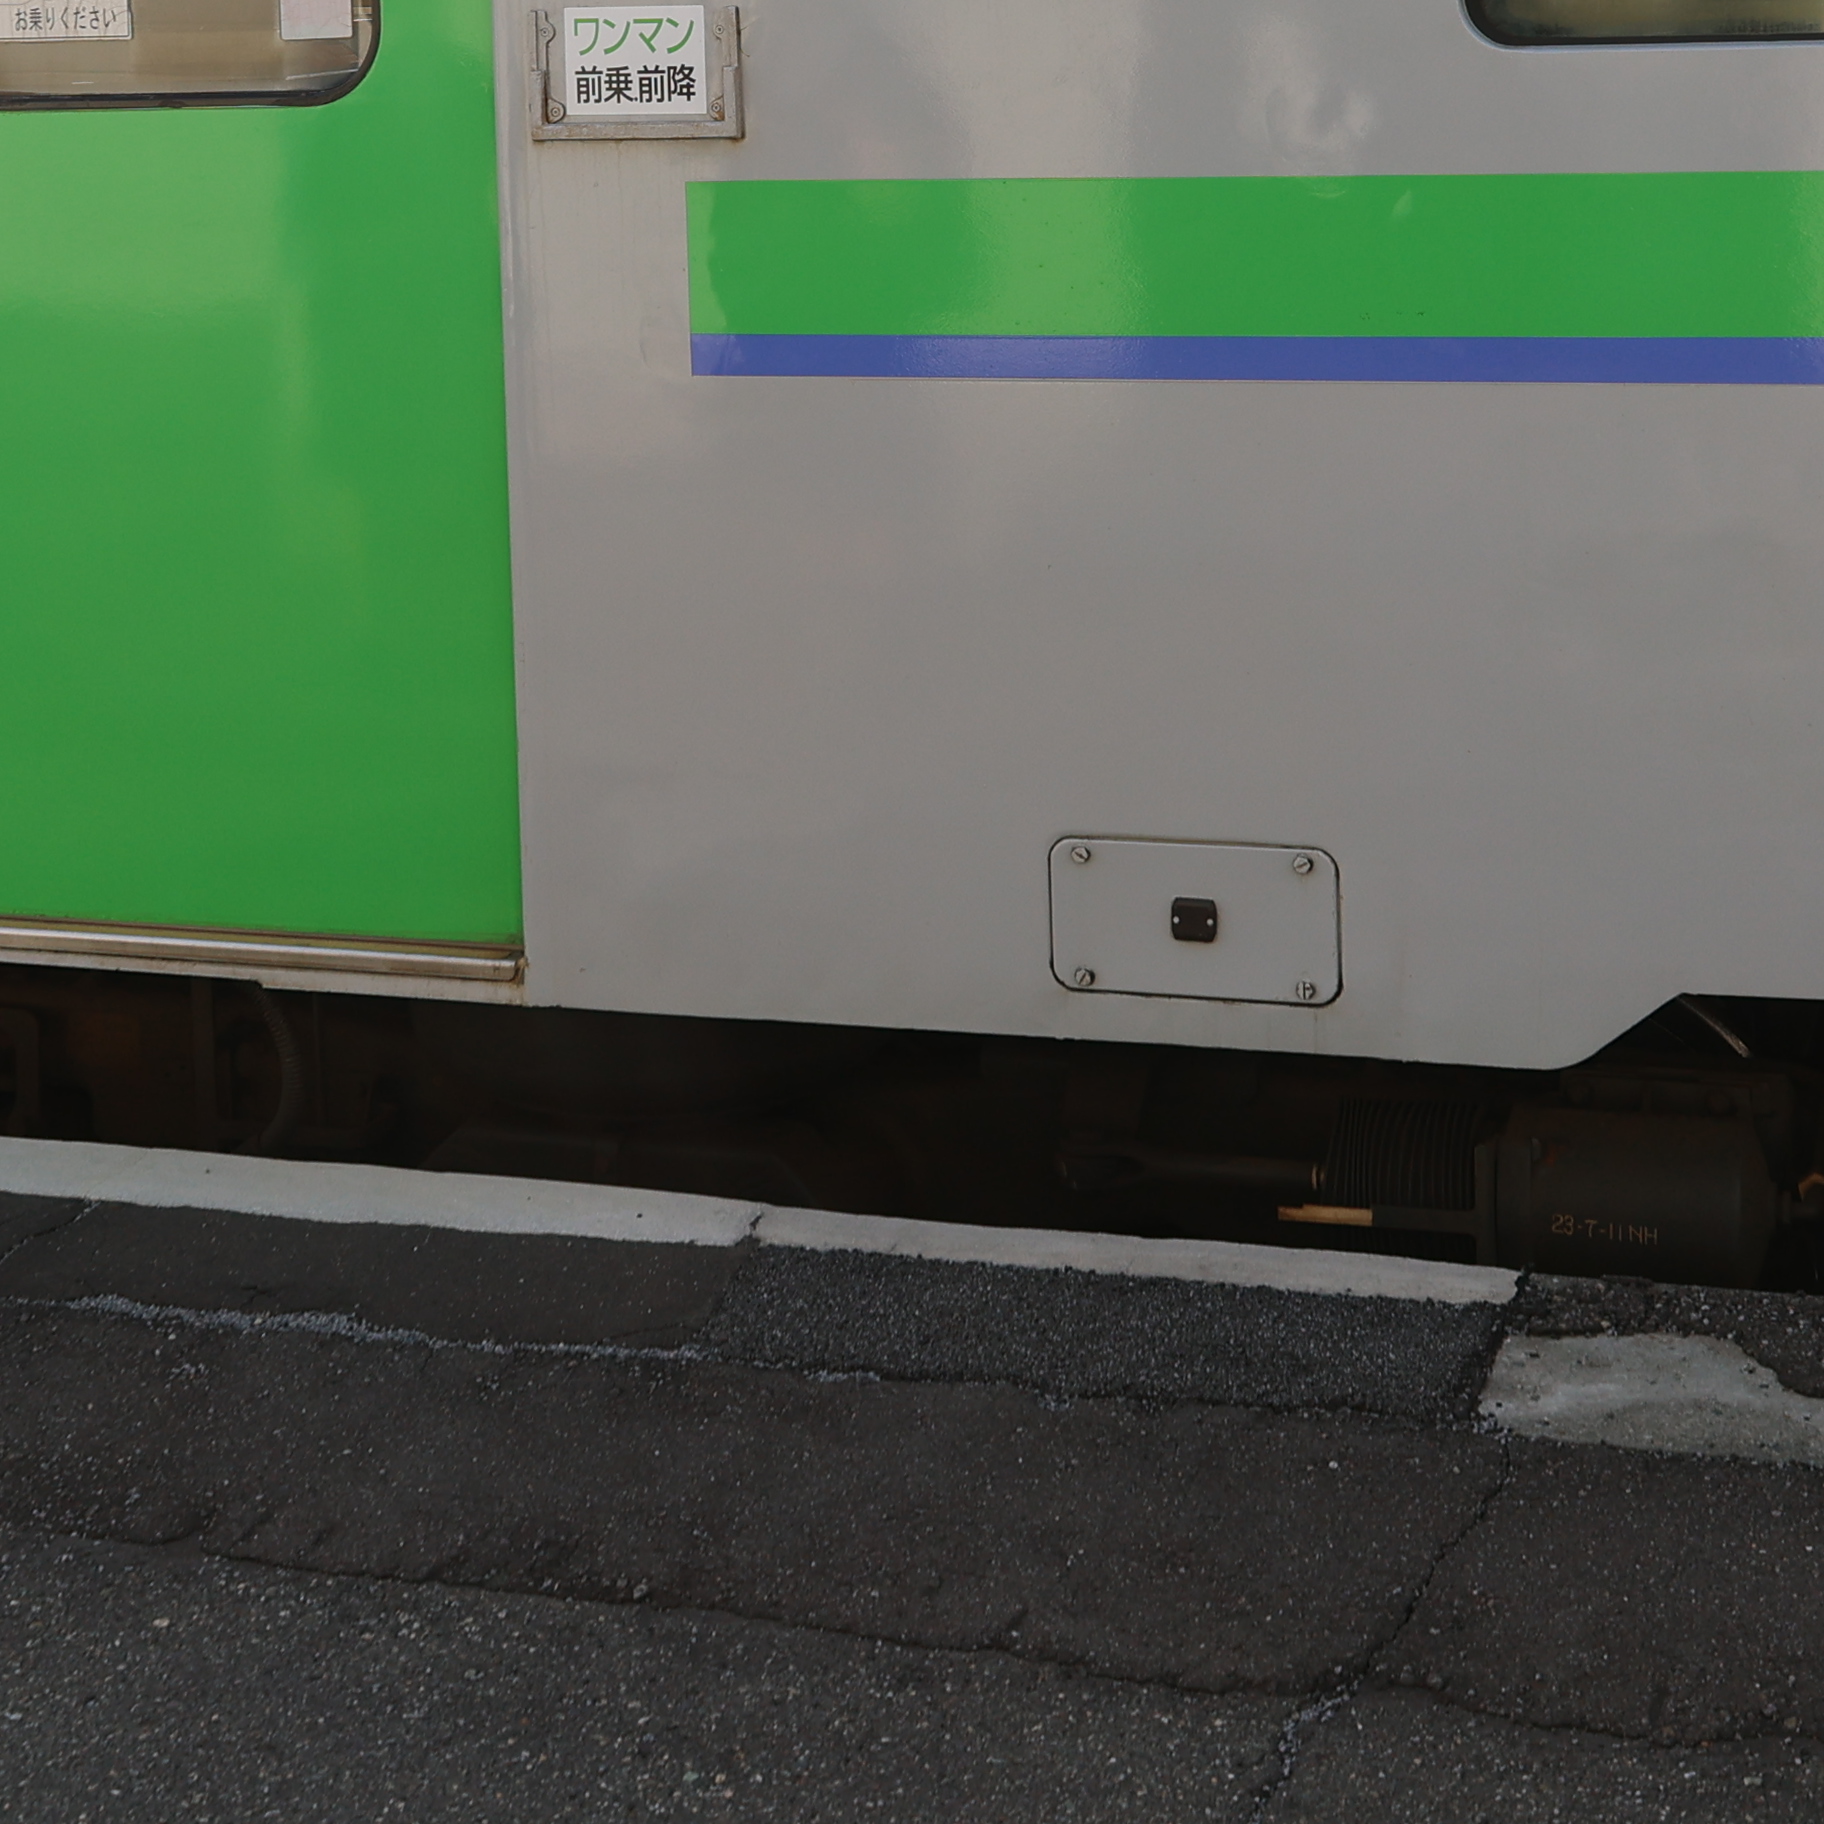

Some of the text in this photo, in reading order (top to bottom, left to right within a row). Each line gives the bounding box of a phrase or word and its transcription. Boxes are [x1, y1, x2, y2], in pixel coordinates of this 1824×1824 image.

[14, 6, 117, 31] お乗りください
[573, 17, 695, 56] ワンマン
